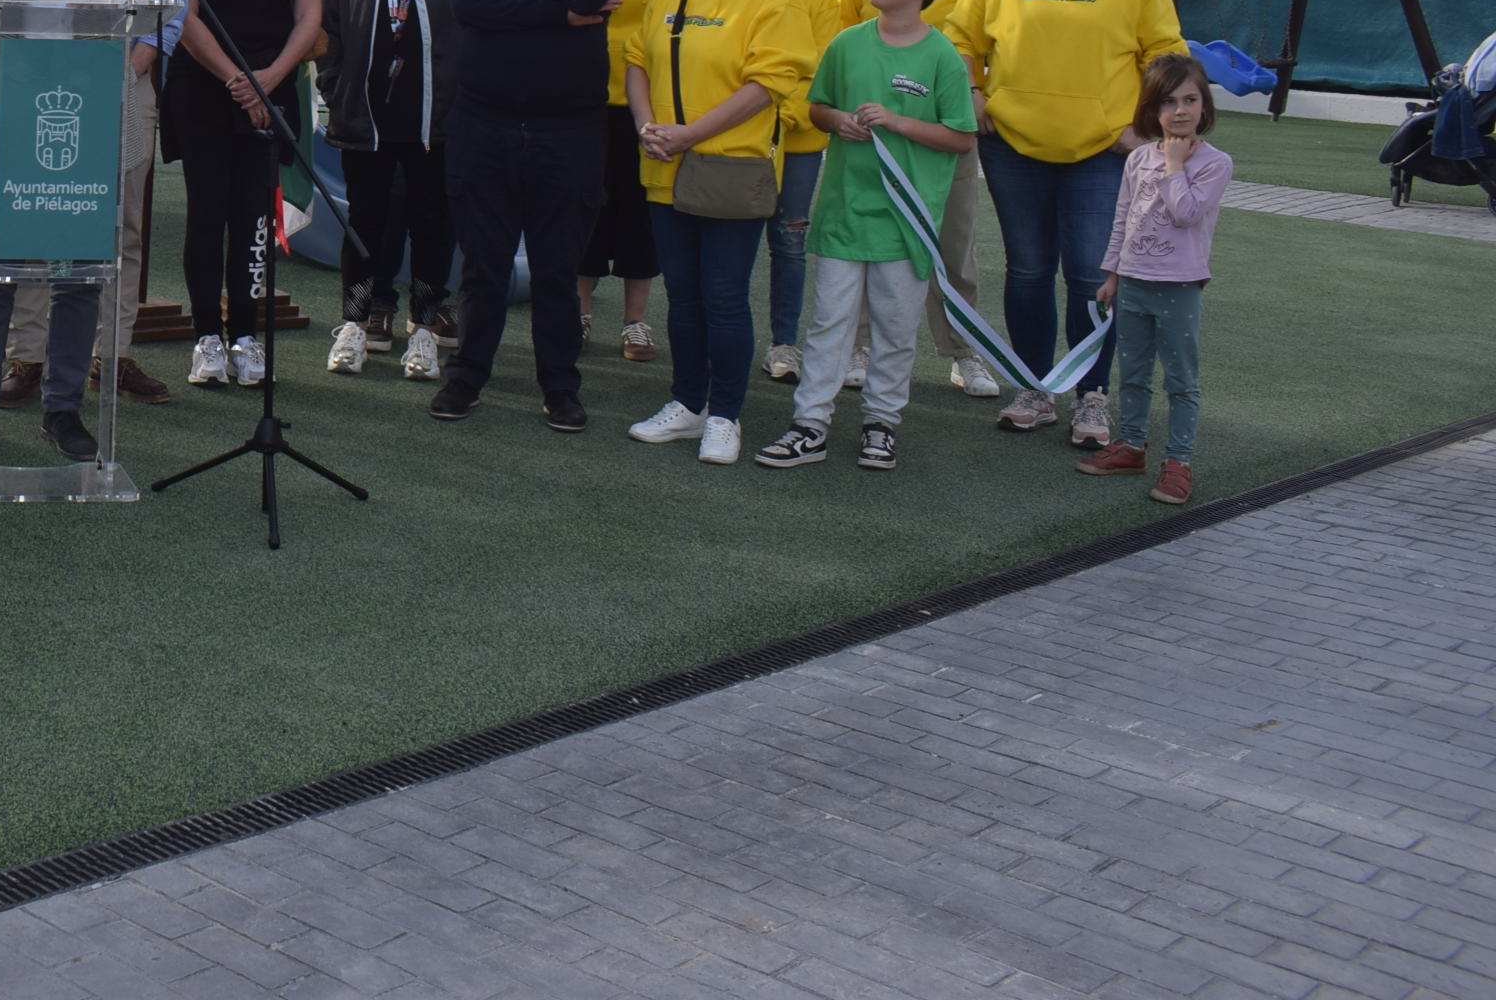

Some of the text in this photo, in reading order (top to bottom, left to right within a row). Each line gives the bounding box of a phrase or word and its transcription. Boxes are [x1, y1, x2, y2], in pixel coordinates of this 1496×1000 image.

[3, 179, 109, 198] Ayuntamiento
[12, 196, 99, 215] de Piélagos
[248, 215, 268, 299] adidas
